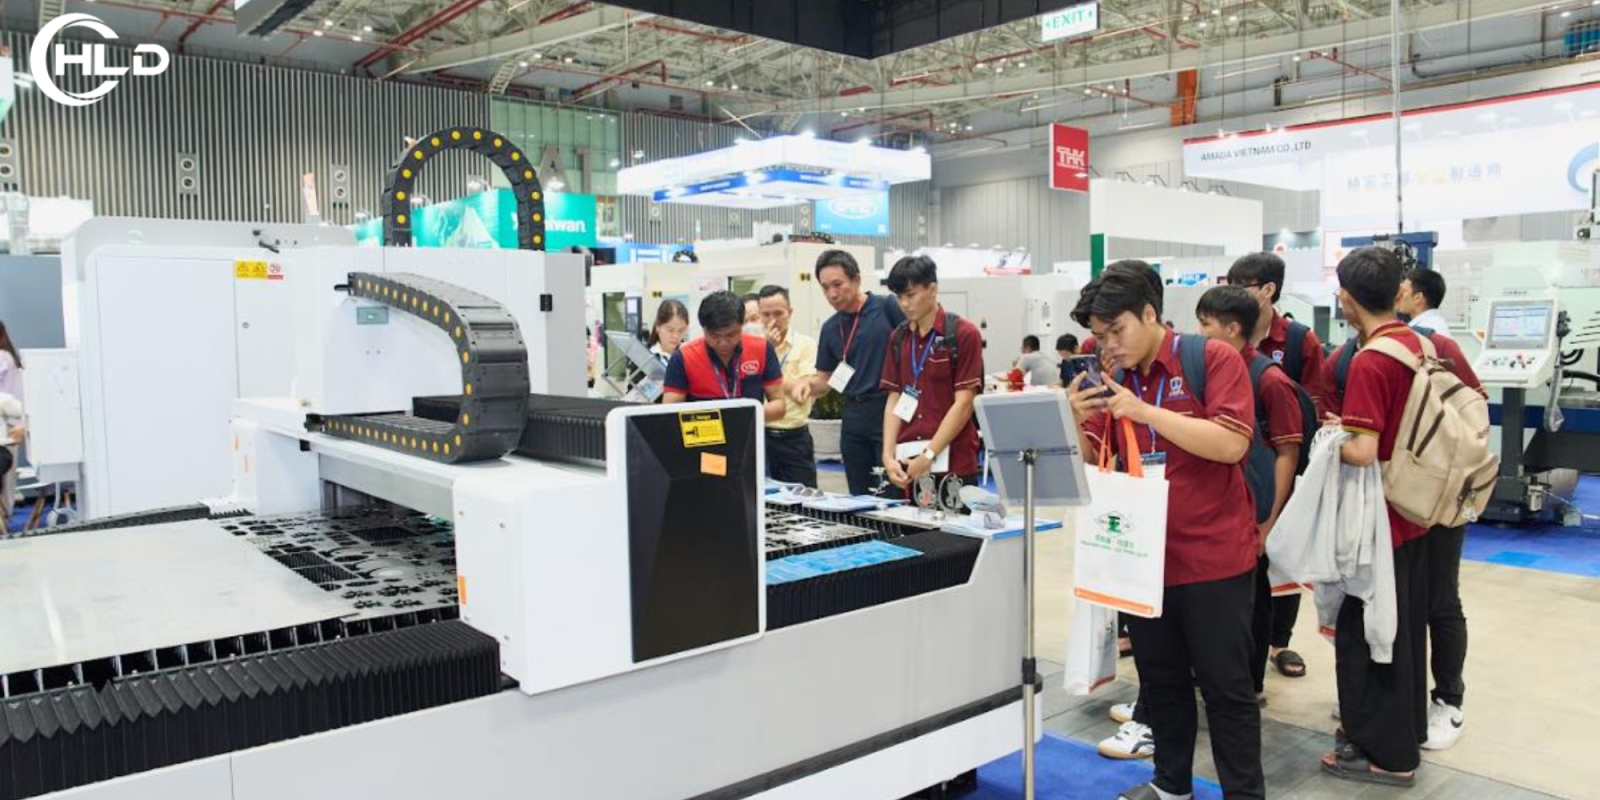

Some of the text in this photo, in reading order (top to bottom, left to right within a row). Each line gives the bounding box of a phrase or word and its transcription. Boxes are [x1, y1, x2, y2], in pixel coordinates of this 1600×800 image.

[1052, 9, 1085, 29] EXIT
[1056, 146, 1085, 167] THK
[1200, 150, 1232, 161] AMADA
[1234, 145, 1275, 158] VIETNAM
